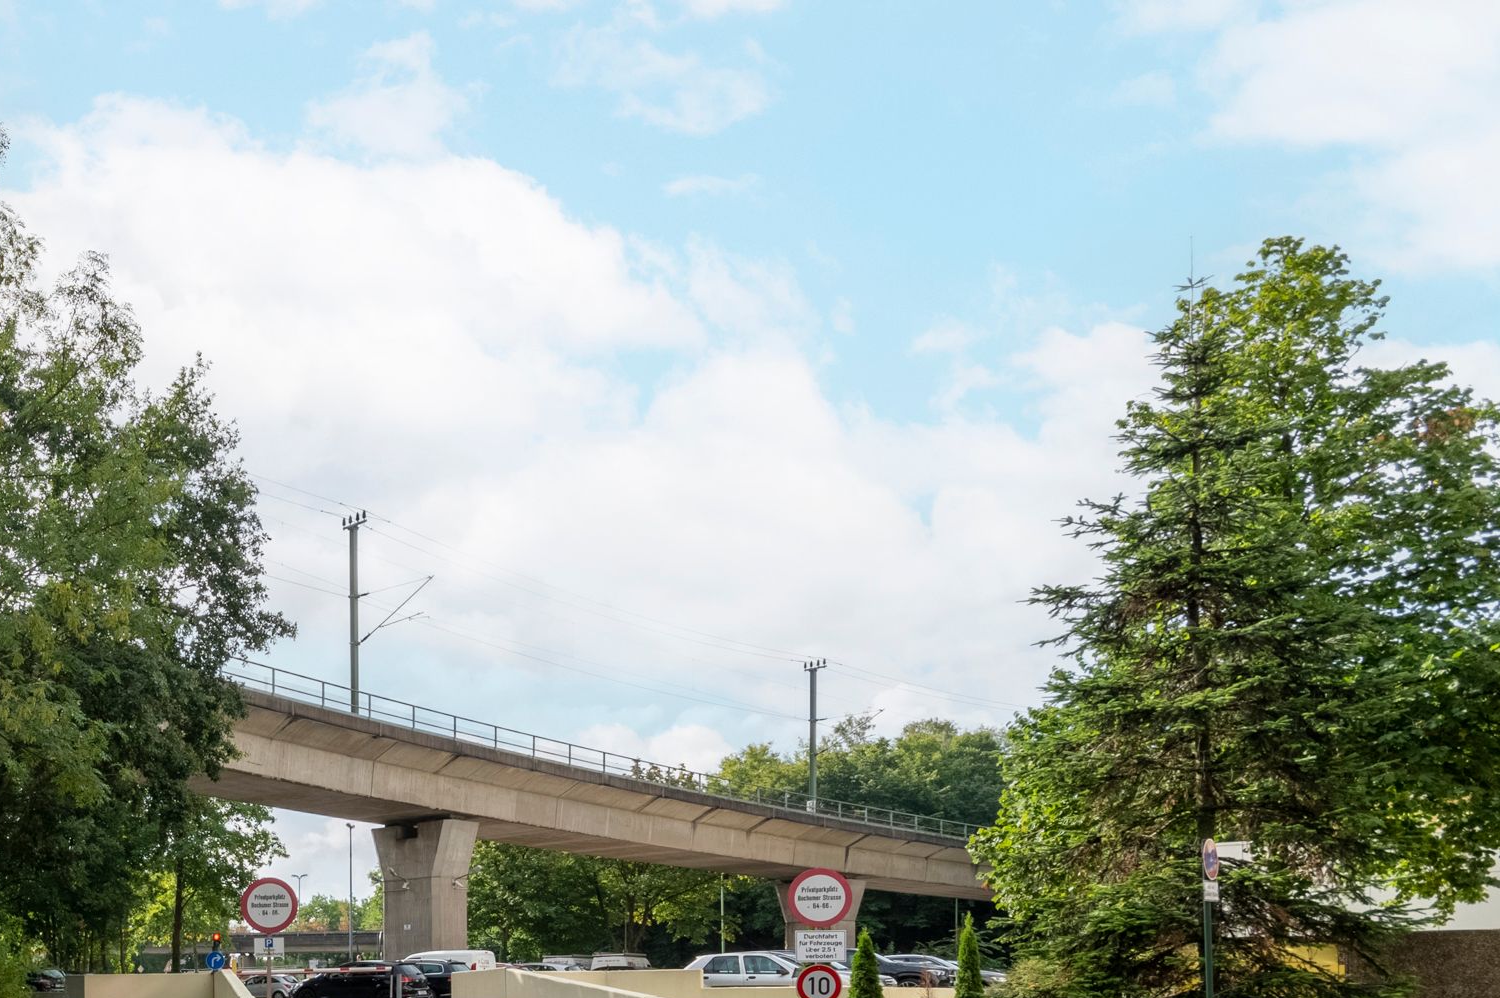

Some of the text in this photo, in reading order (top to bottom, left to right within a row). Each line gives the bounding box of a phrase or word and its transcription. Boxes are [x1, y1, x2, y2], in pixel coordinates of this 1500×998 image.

[801, 885, 838, 894] Privatparkplatz
[797, 894, 821, 902] Bochumer
[808, 977, 830, 995] 10
